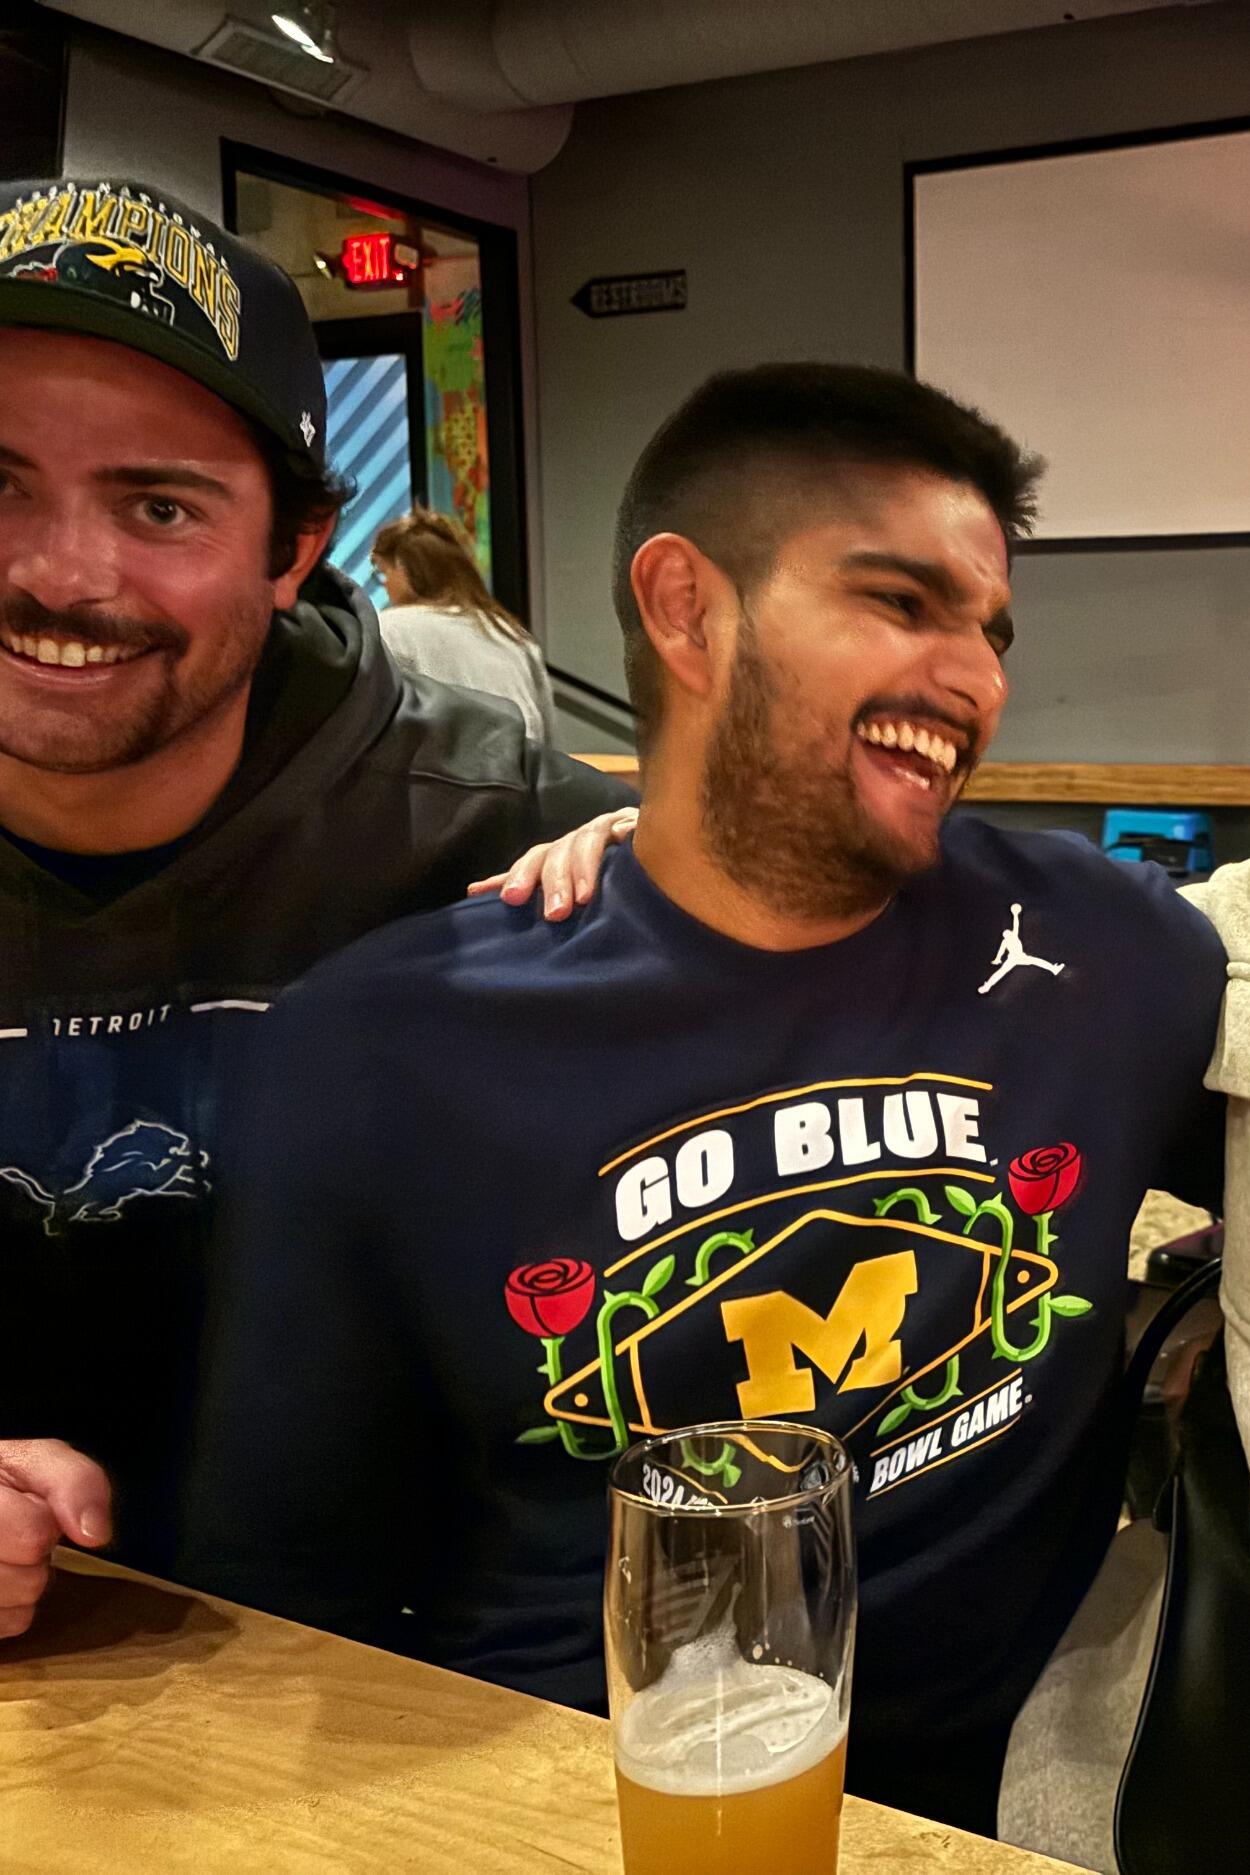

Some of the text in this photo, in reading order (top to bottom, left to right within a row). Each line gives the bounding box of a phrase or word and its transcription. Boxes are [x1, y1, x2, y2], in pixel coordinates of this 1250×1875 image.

[351, 236, 390, 282] EXIT
[615, 1090, 987, 1241] GO BLUE
[720, 1249, 918, 1420] M
[869, 1427, 943, 1493] BOWL
[951, 1376, 1024, 1447] GAME
